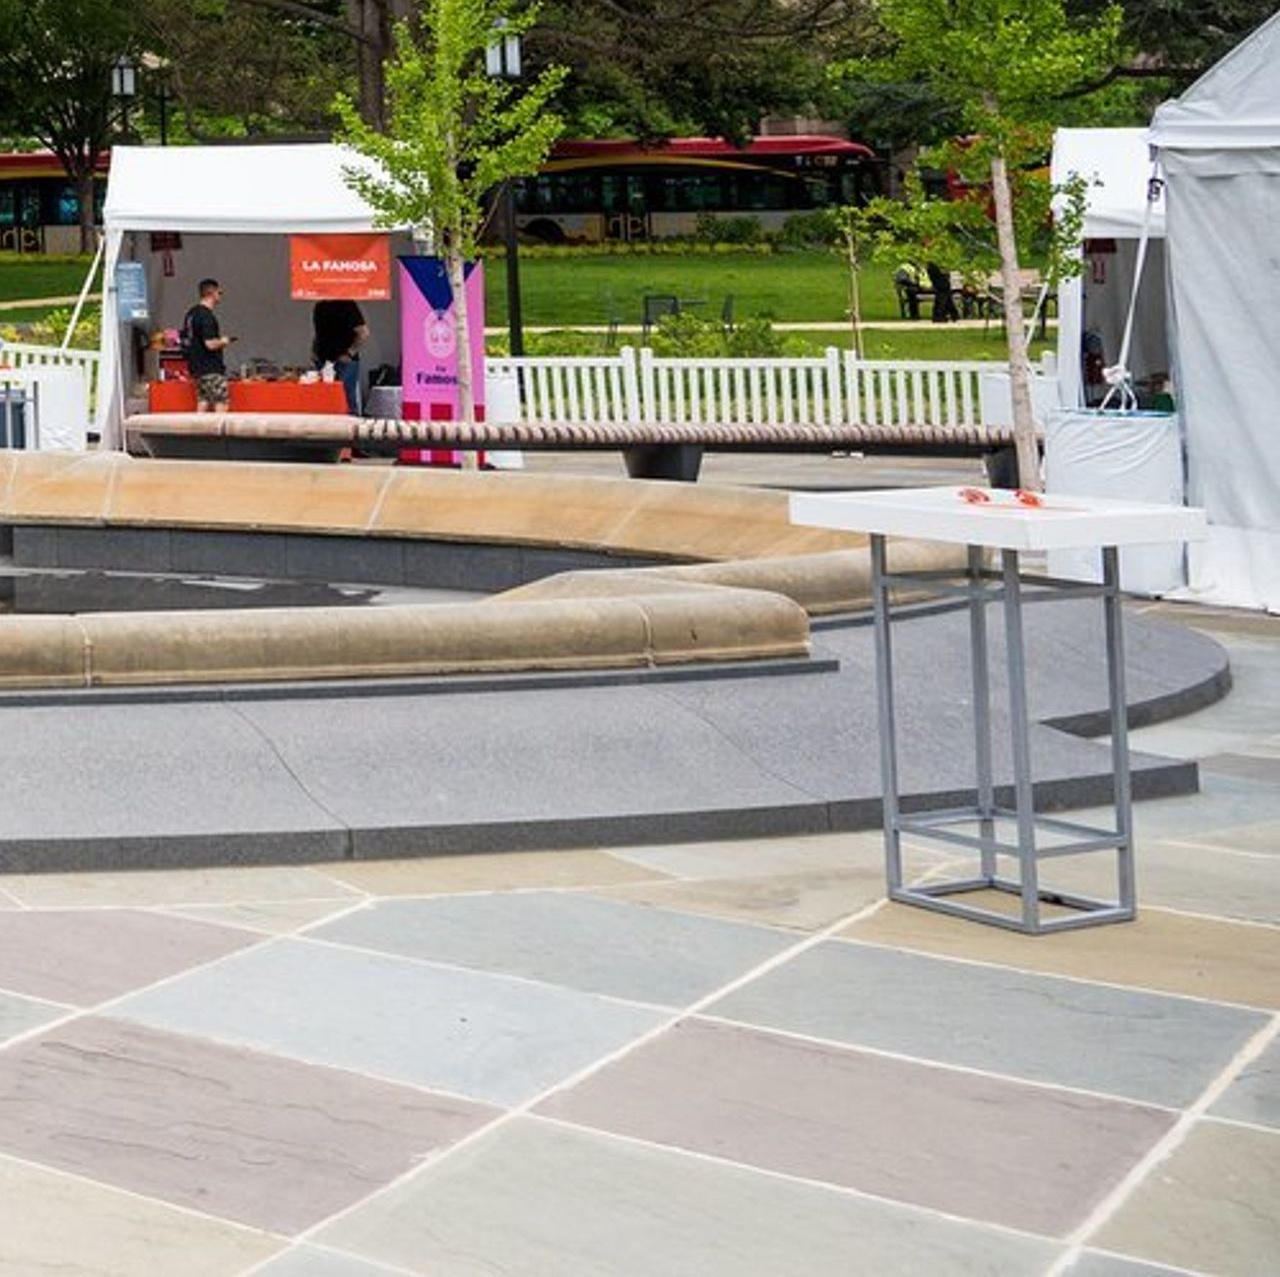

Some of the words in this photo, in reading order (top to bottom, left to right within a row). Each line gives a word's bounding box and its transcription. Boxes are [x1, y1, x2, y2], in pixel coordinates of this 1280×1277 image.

[301, 260, 321, 272] LA
[322, 260, 378, 272] FAMOSA
[416, 373, 459, 384] Famos
